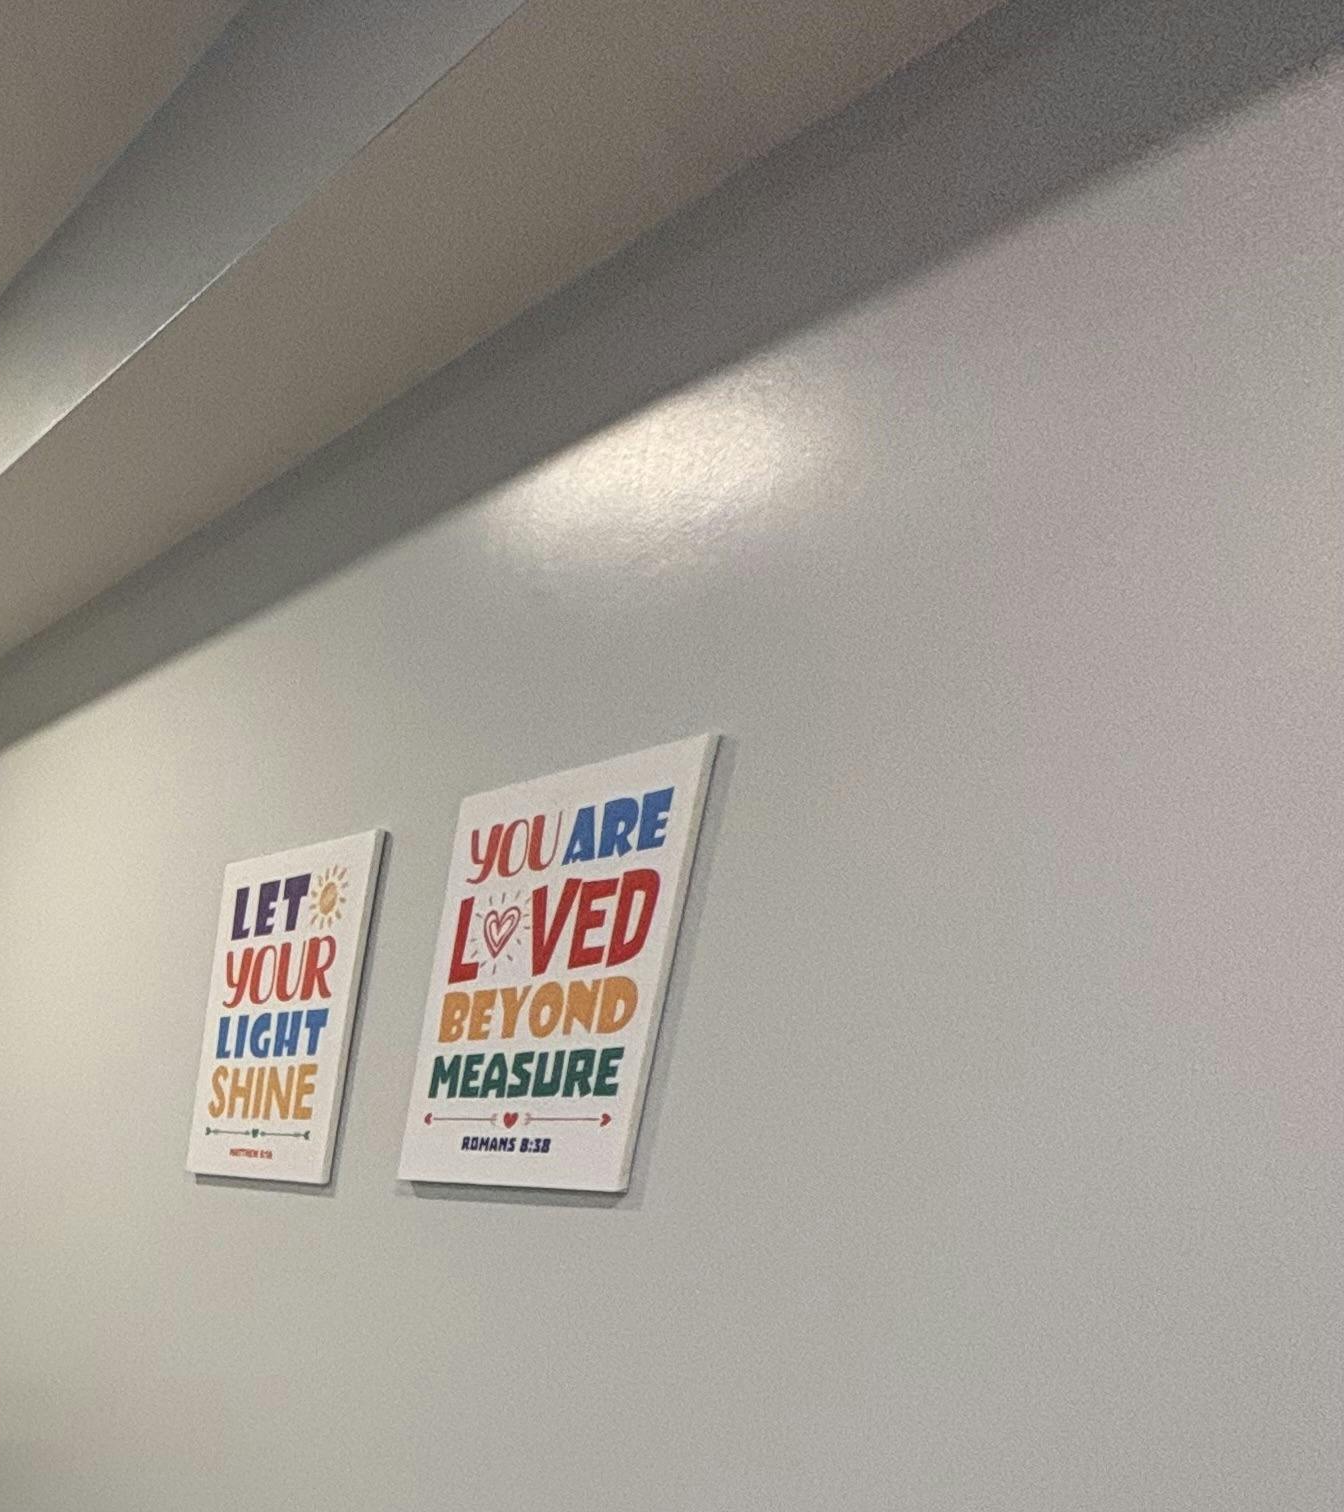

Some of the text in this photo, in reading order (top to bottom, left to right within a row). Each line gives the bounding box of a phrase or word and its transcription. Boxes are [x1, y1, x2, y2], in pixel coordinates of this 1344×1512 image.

[465, 786, 675, 884] YOU ARE
[230, 873, 312, 940] LET
[222, 935, 336, 1009] YOUR
[215, 1008, 329, 1060] LIGHT
[437, 976, 639, 1044] BEYOND
[208, 1064, 319, 1120] SHINE
[427, 1046, 625, 1100] MEASURE
[461, 1137, 551, 1153] ROMANS 8:38
